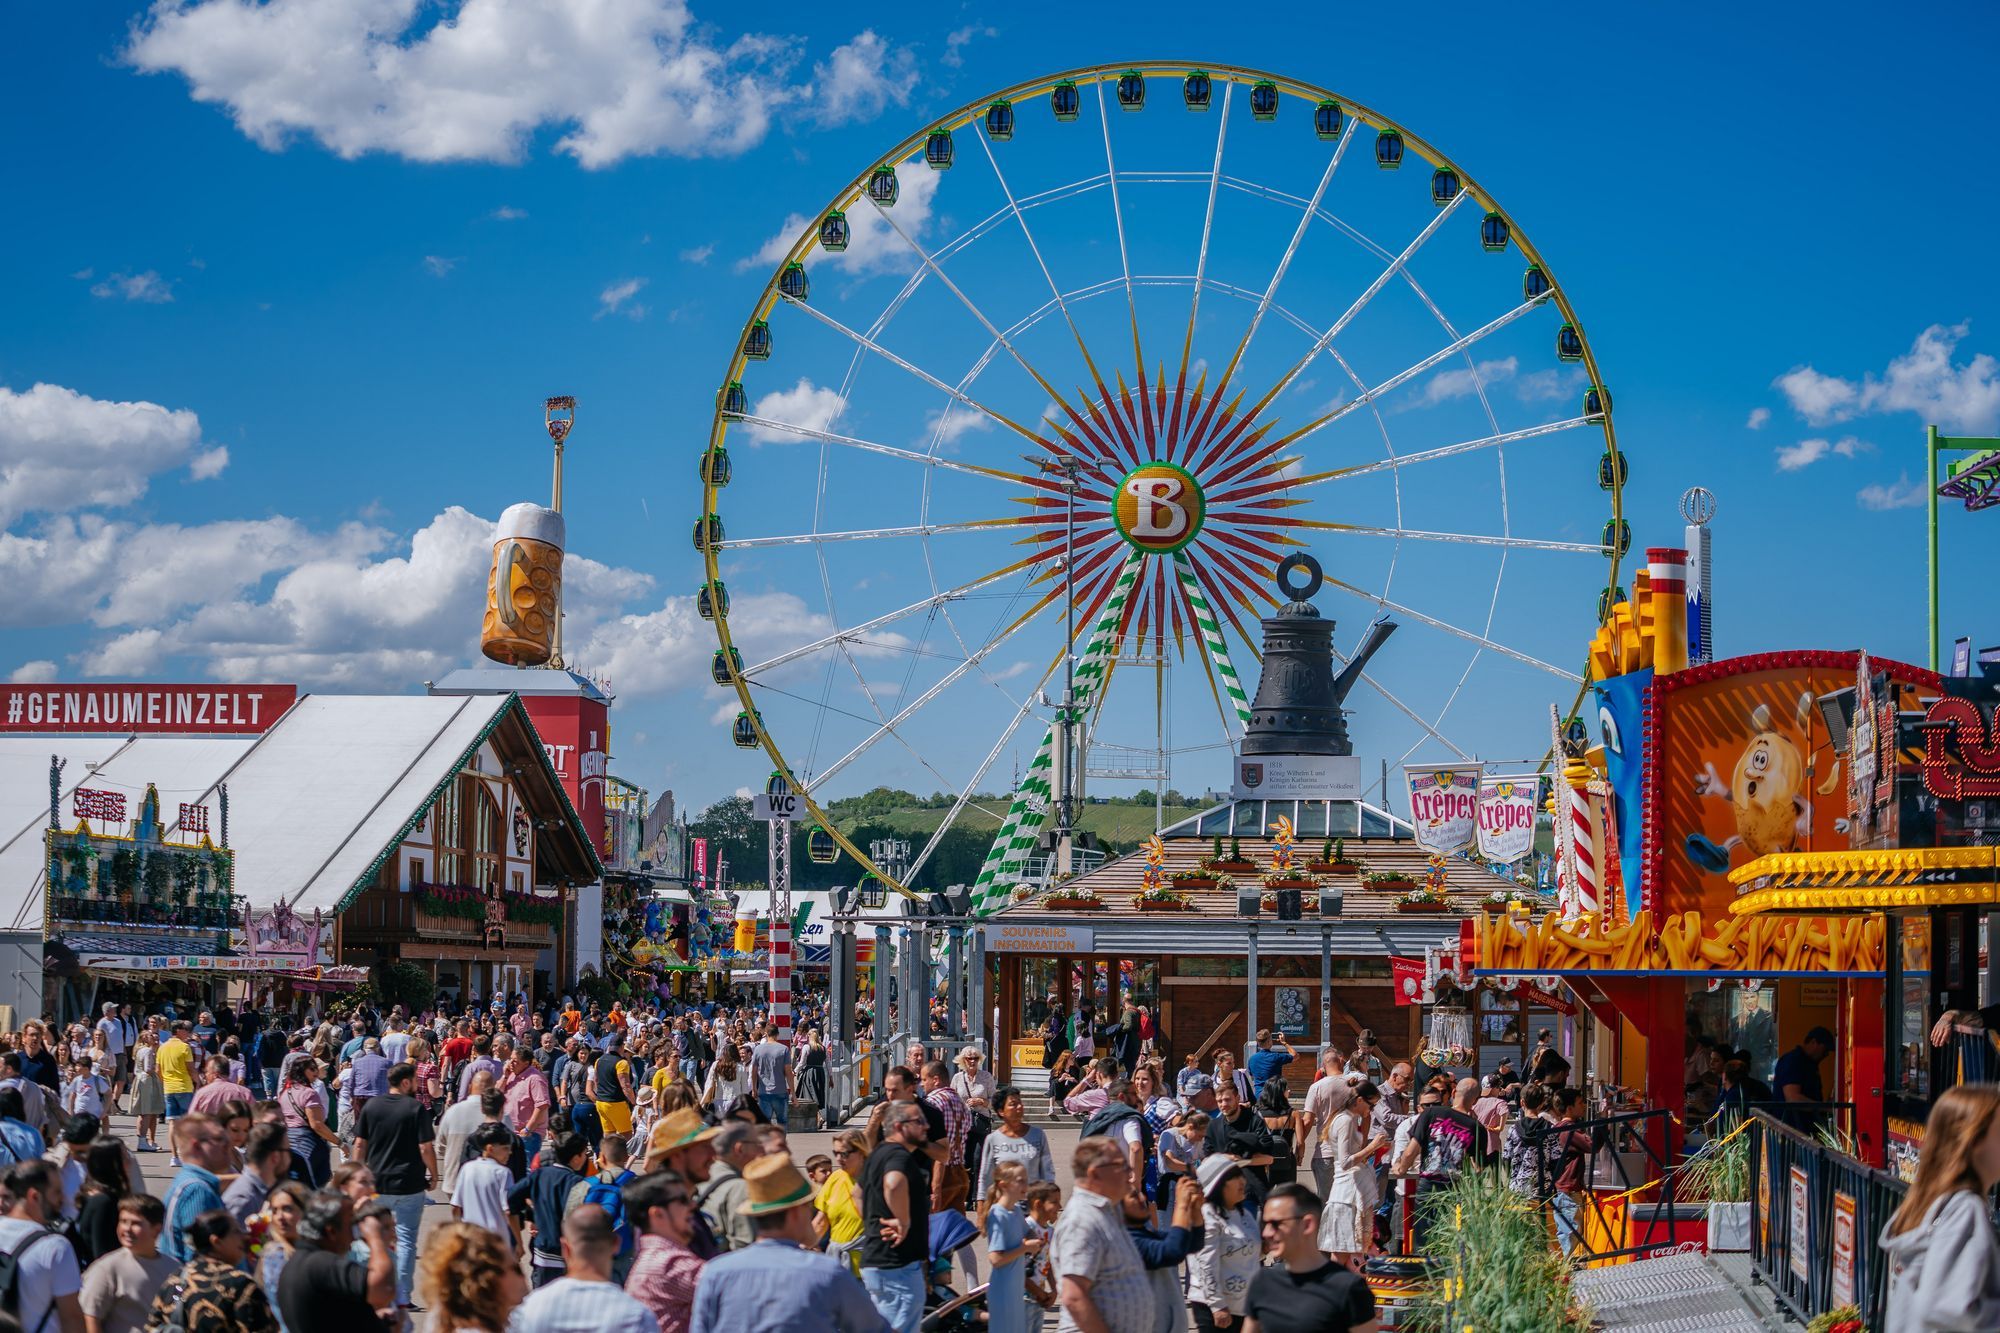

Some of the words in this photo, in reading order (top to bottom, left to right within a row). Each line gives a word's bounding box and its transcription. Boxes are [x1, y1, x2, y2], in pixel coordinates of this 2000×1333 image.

[1127, 477, 1190, 542] B
[8, 692, 263, 725] #GENAUMEINZELT
[768, 795, 796, 812] WC
[1412, 790, 1477, 822] Crêpes
[1478, 800, 1533, 832] Crêpes
[1002, 927, 1067, 938] SOUVENIRS
[993, 940, 1076, 951] INFORMATION
[1395, 962, 1426, 975] Zuckerwat
[1025, 1048, 1043, 1056] Souven
